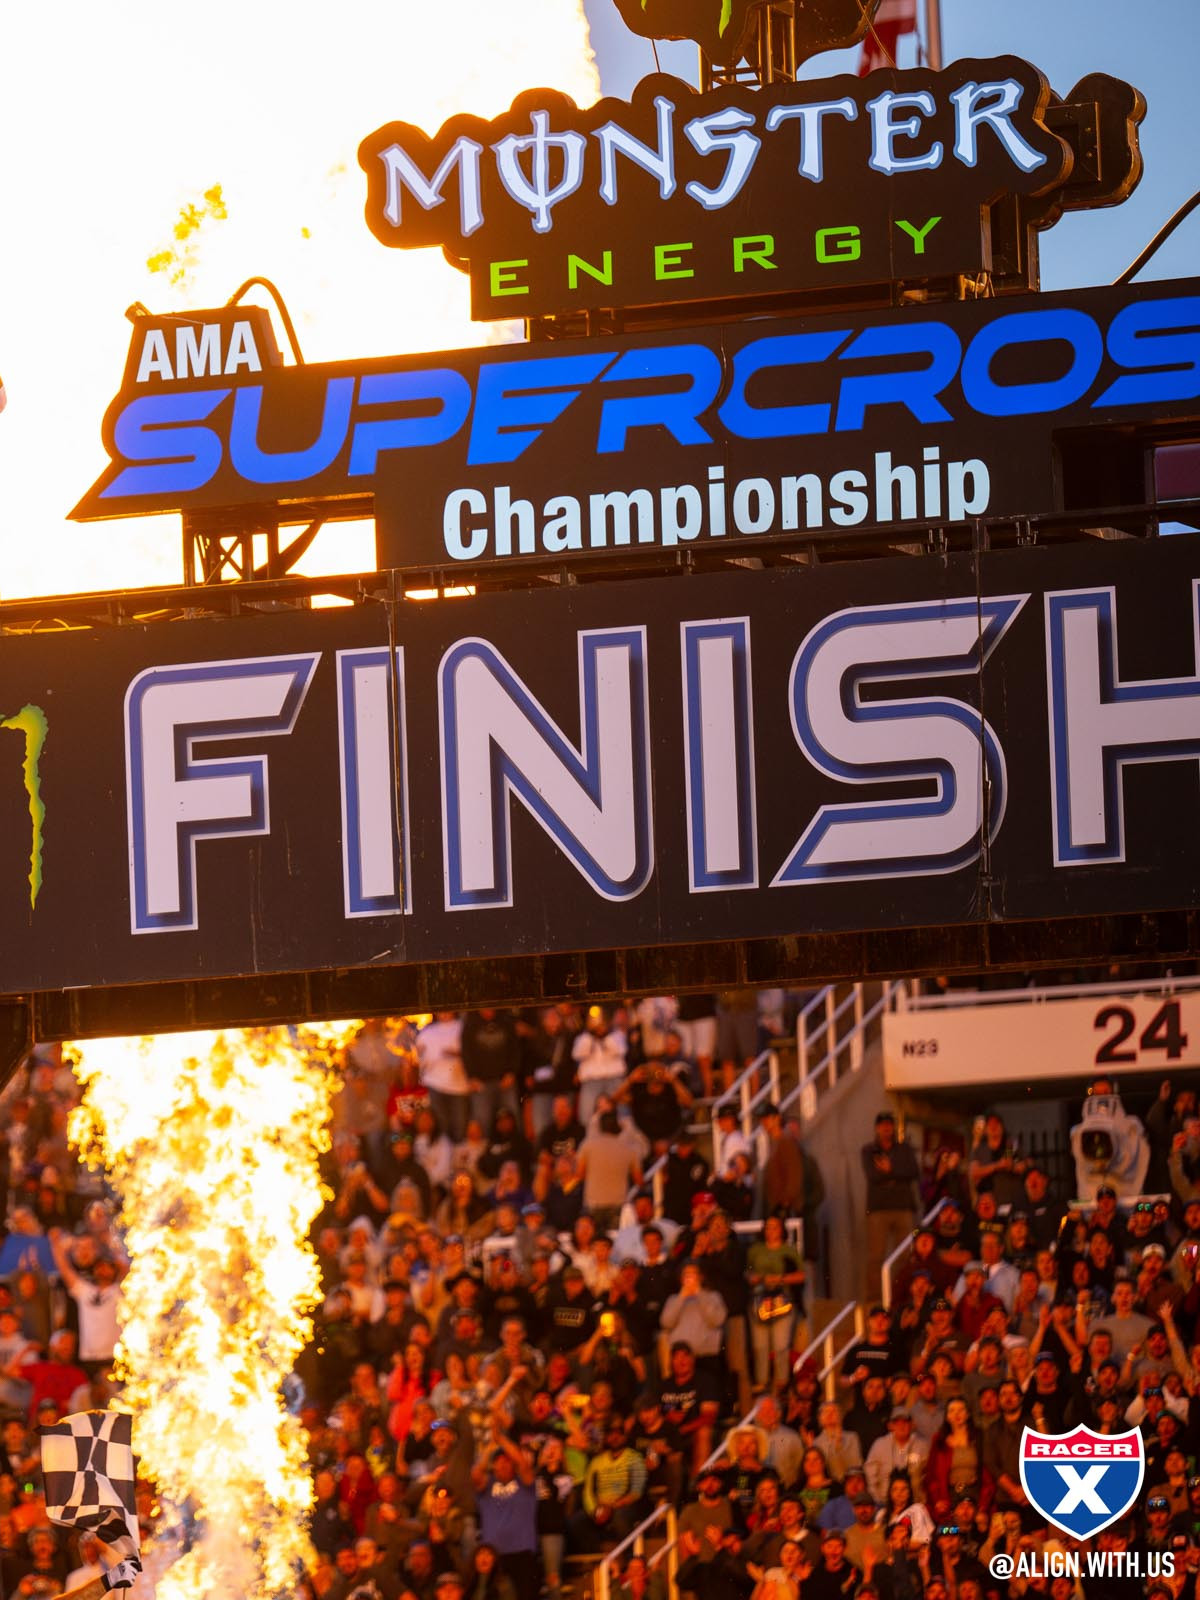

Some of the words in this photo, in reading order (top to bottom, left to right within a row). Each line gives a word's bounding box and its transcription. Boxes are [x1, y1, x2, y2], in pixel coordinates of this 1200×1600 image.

[489, 215, 942, 298] ENERGY
[136, 321, 262, 383] AMA
[443, 445, 992, 562] Championship
[124, 579, 1200, 936] FINISH
[902, 1039, 938, 1058] N23
[1093, 1001, 1188, 1066] 24
